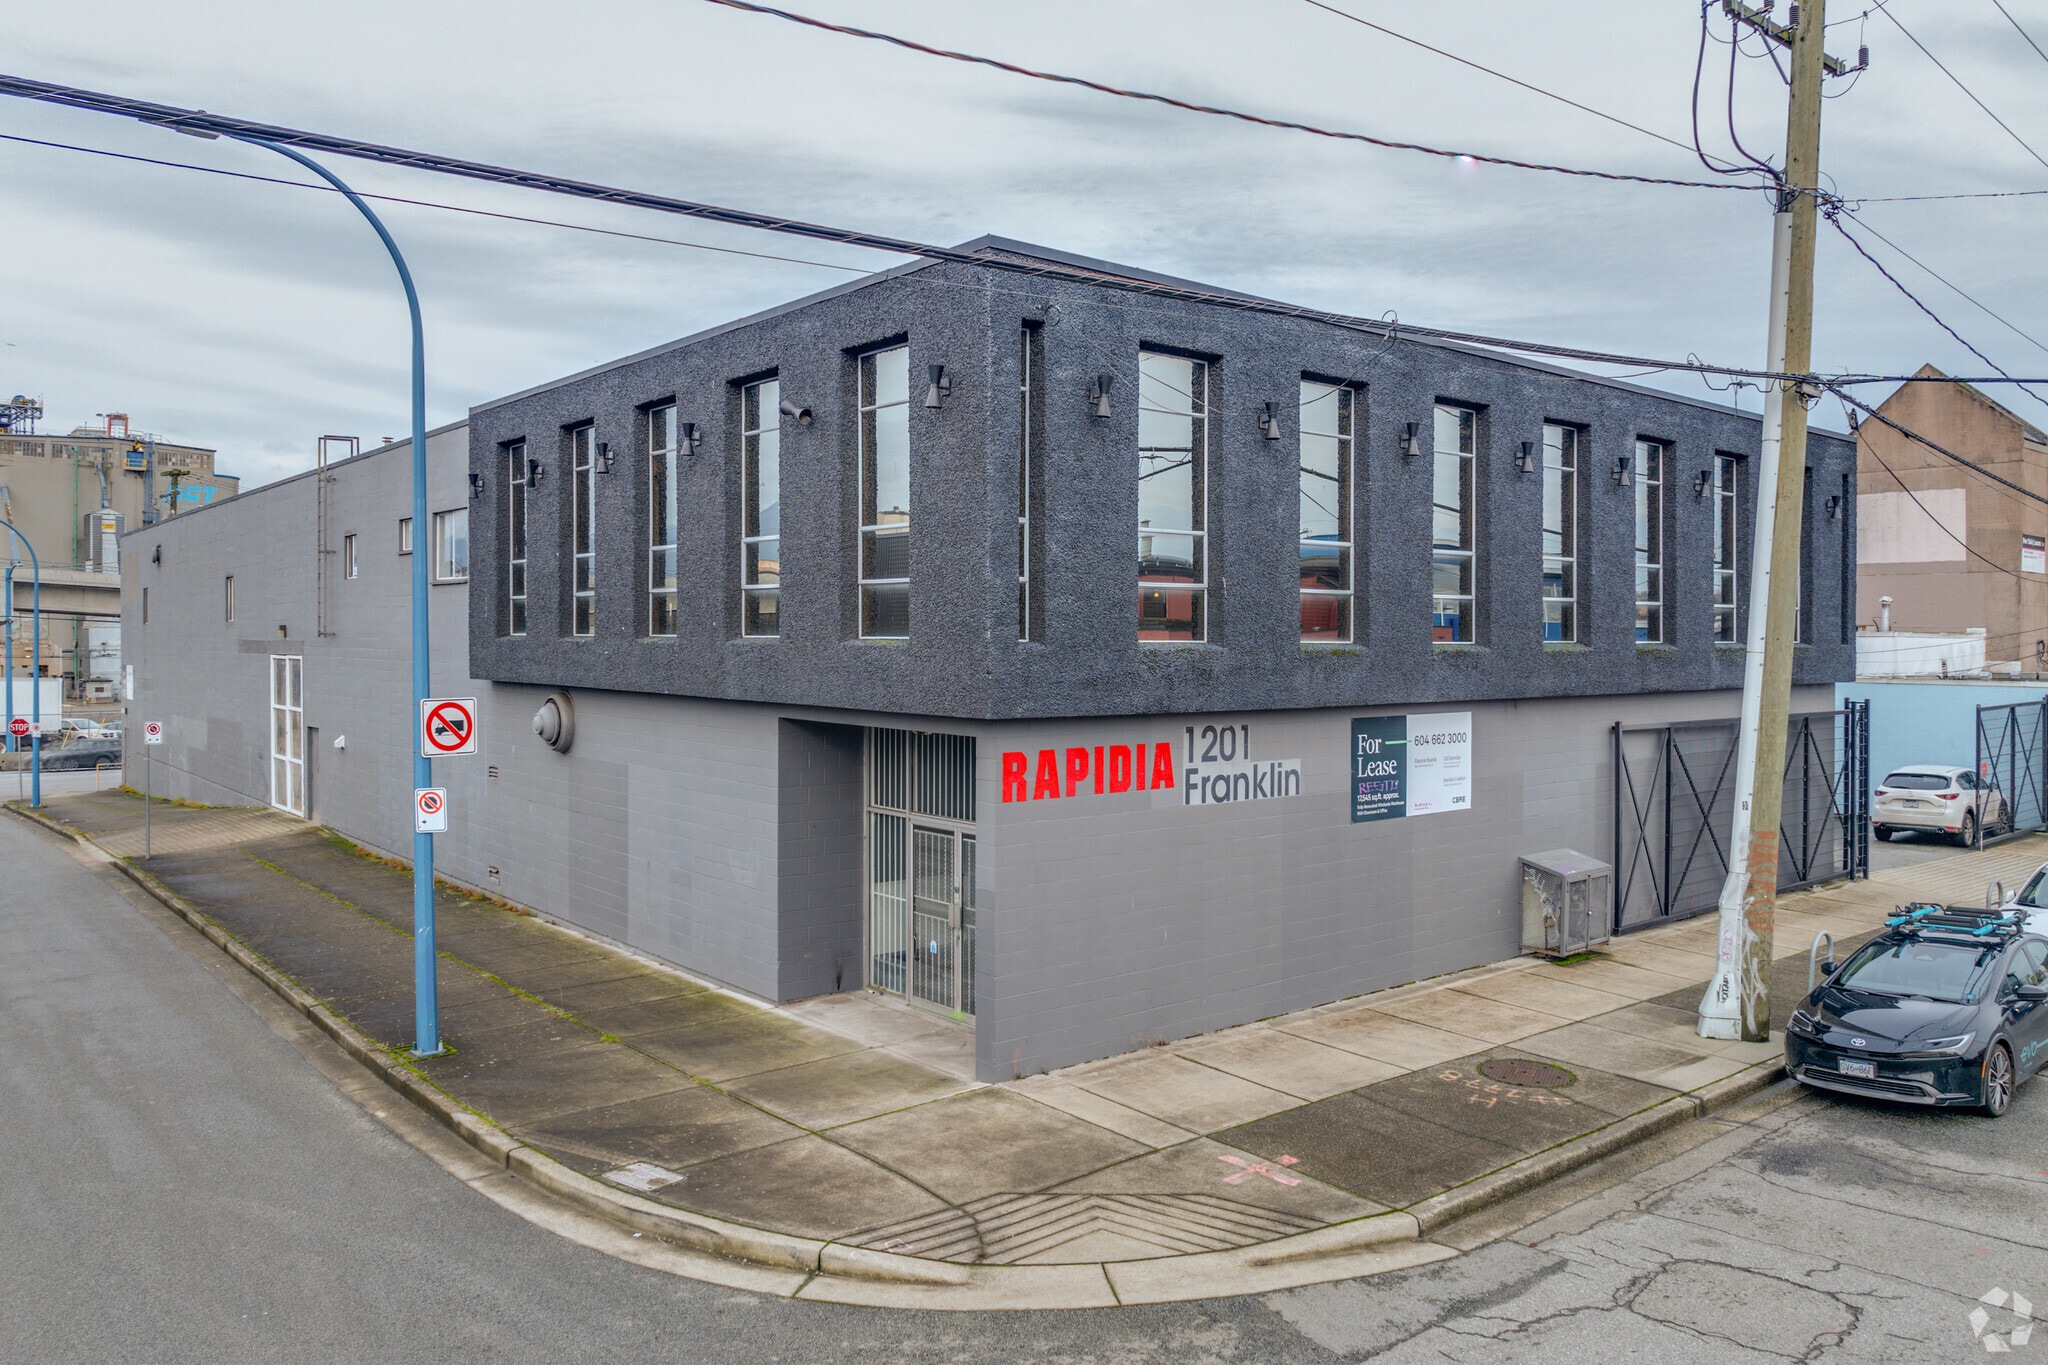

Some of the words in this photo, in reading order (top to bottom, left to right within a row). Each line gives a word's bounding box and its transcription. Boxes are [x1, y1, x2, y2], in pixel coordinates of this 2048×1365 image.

[10, 723, 29, 732] STOP
[1185, 723, 1249, 764] 1201
[1357, 733, 1382, 755] For
[1414, 734, 1430, 747] 604
[1431, 733, 1446, 745] 662
[1447, 732, 1467, 744] 3000
[1001, 742, 1175, 803] RAPIDIA
[1356, 757, 1398, 778] Lease
[1185, 761, 1300, 805] Franklin
[1451, 795, 1466, 804] CBRE
